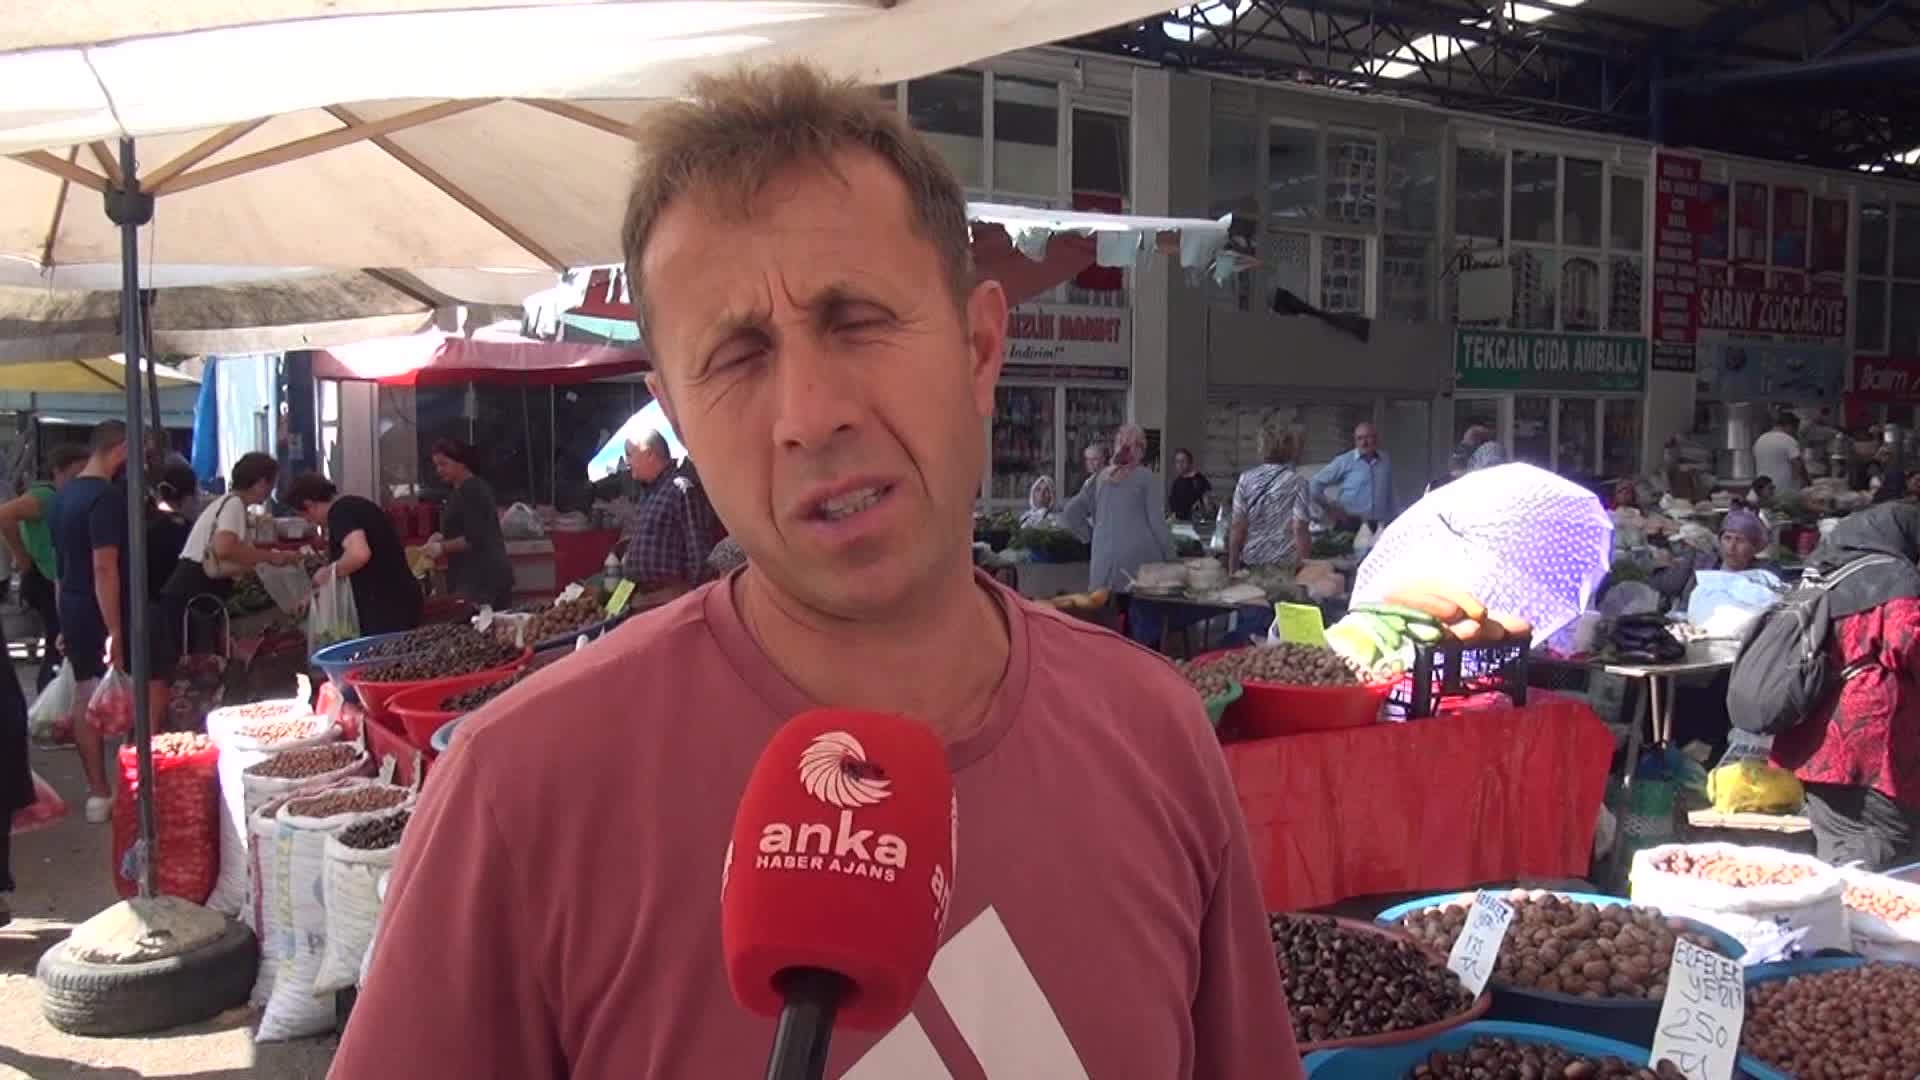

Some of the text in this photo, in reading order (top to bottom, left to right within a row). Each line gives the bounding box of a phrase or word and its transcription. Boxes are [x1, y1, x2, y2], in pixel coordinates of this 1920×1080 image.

[1702, 288, 1755, 329] SARAY
[1463, 335, 1529, 369] TEKCAN
[1533, 340, 1569, 371] GIDA
[759, 810, 907, 869] anka
[756, 855, 896, 883] HABER AJANS
[1662, 1007, 1728, 1049] 250
